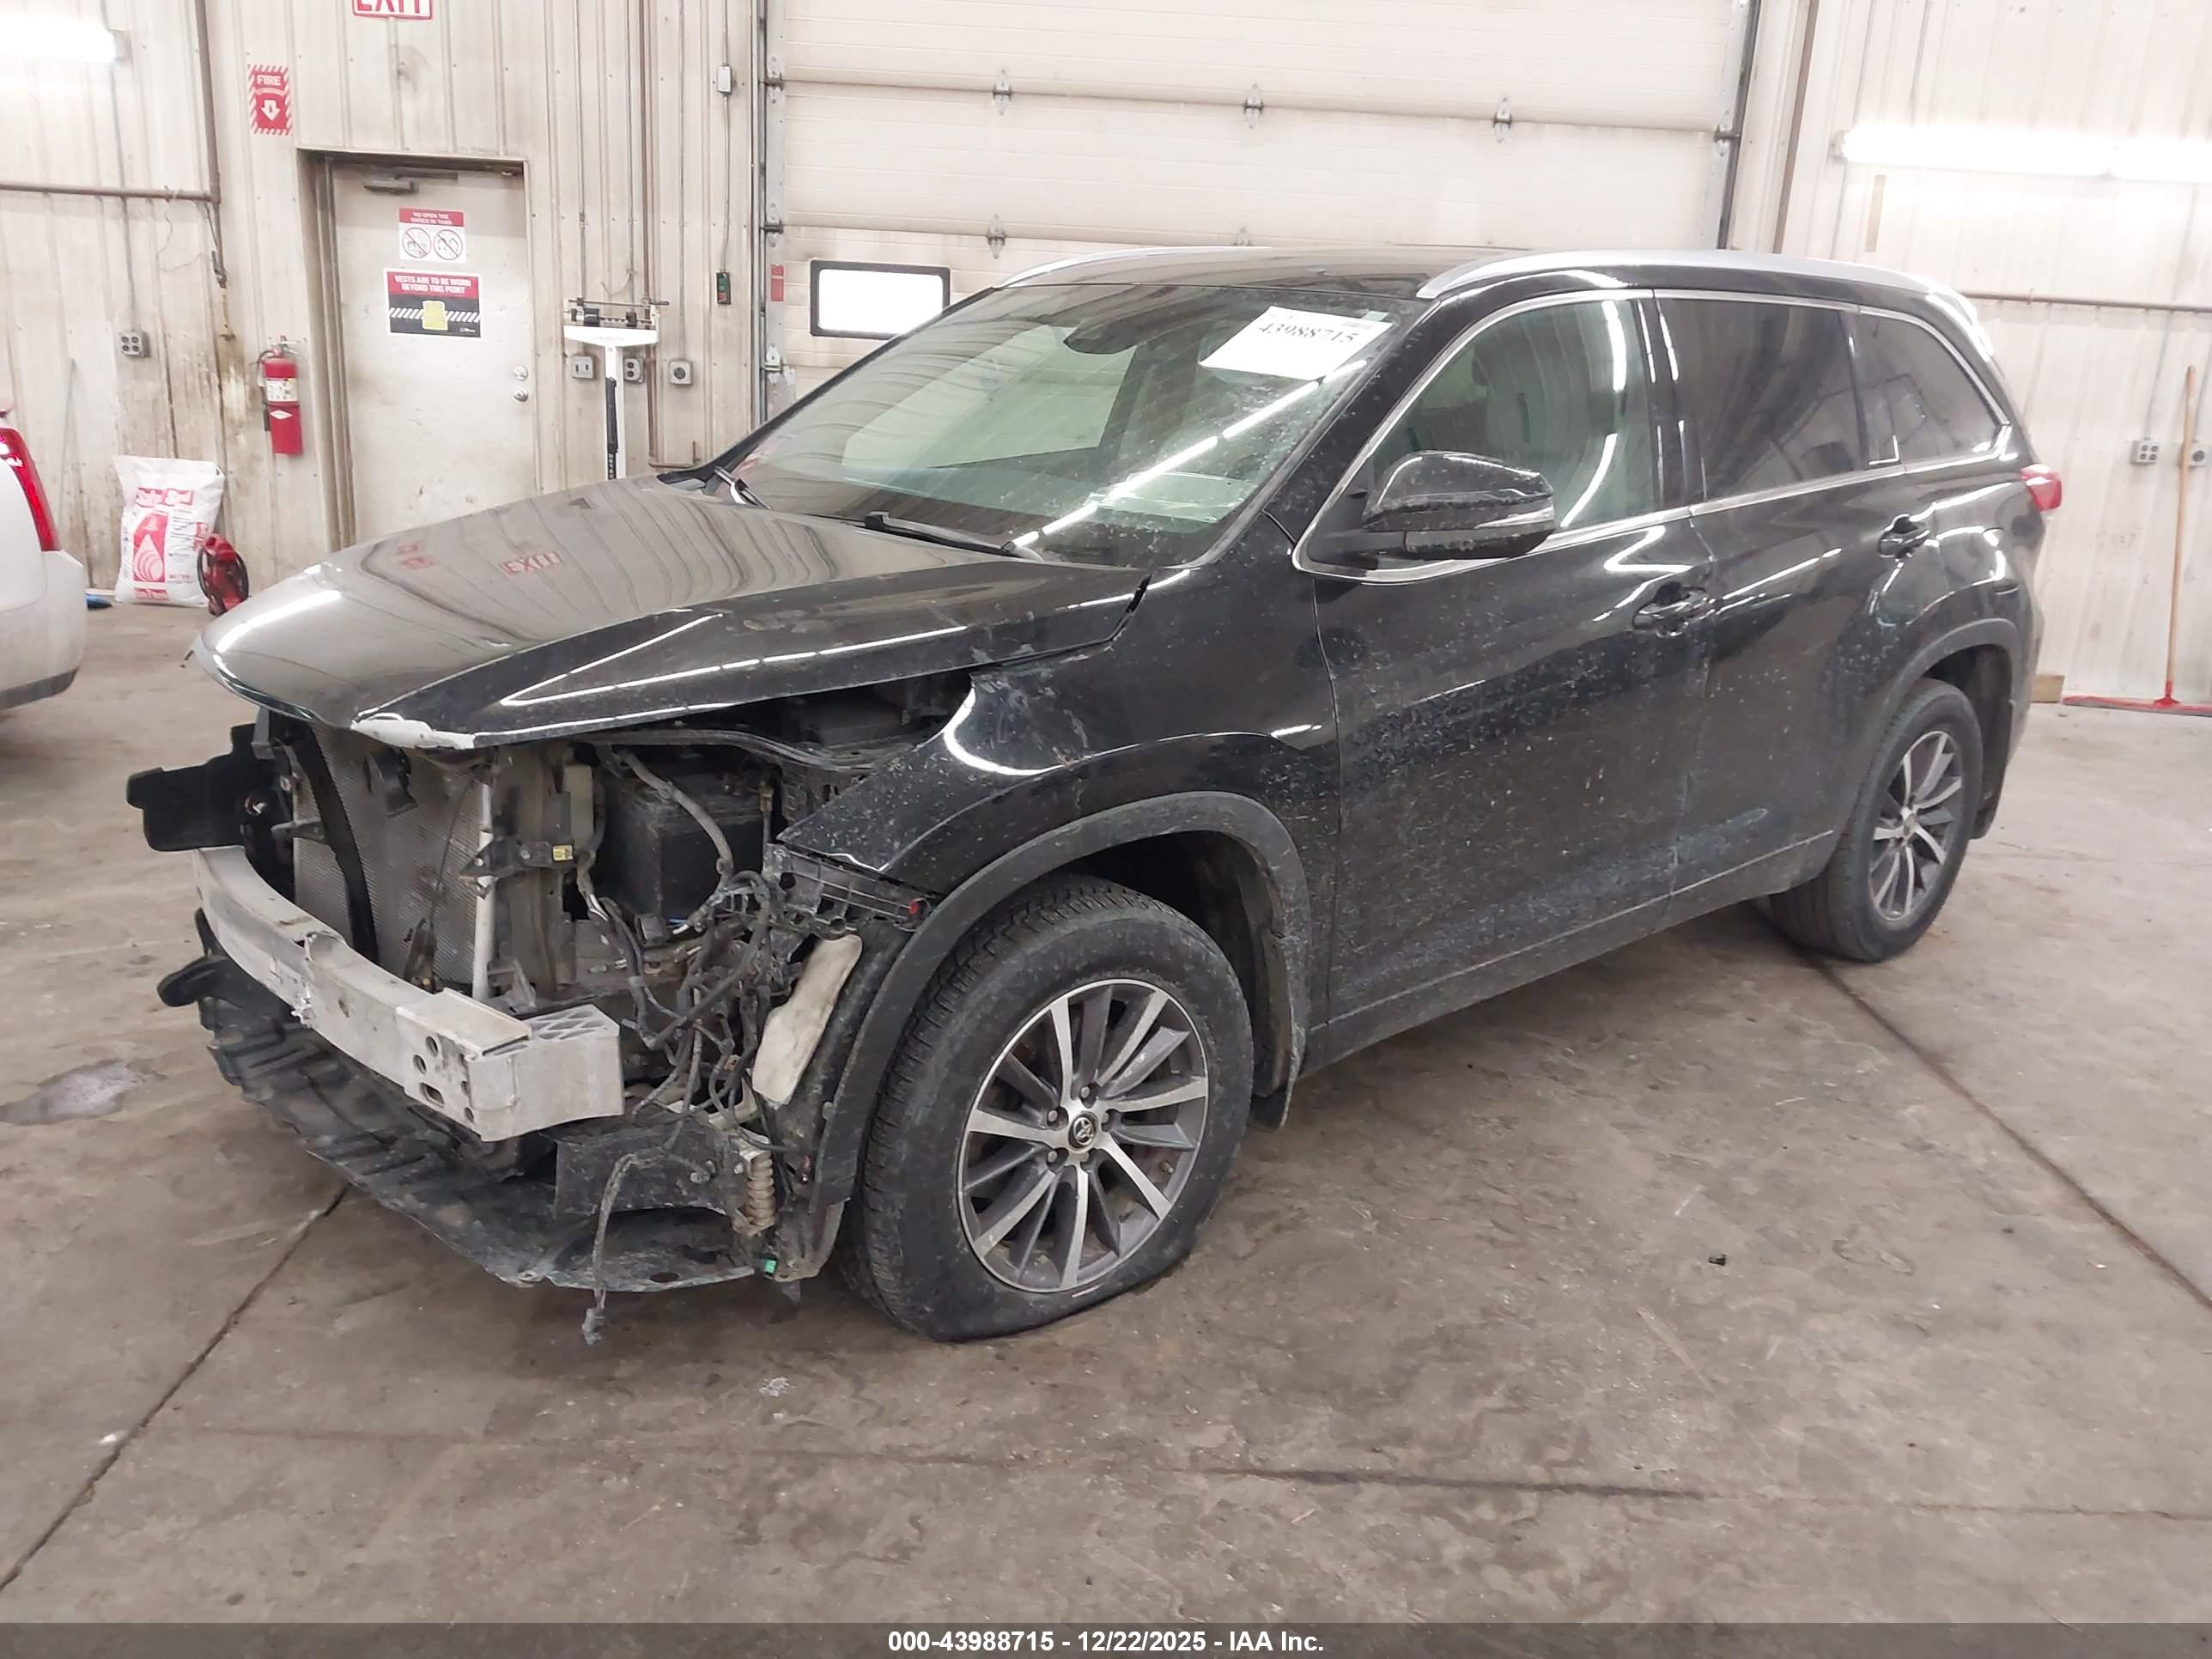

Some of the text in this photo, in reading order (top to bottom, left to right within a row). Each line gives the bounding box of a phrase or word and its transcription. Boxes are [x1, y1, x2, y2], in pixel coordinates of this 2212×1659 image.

[257, 74, 282, 86] FIRE
[394, 275, 416, 283] VESTS
[450, 278, 471, 287] WORN
[1258, 322, 1359, 343] 43988715
